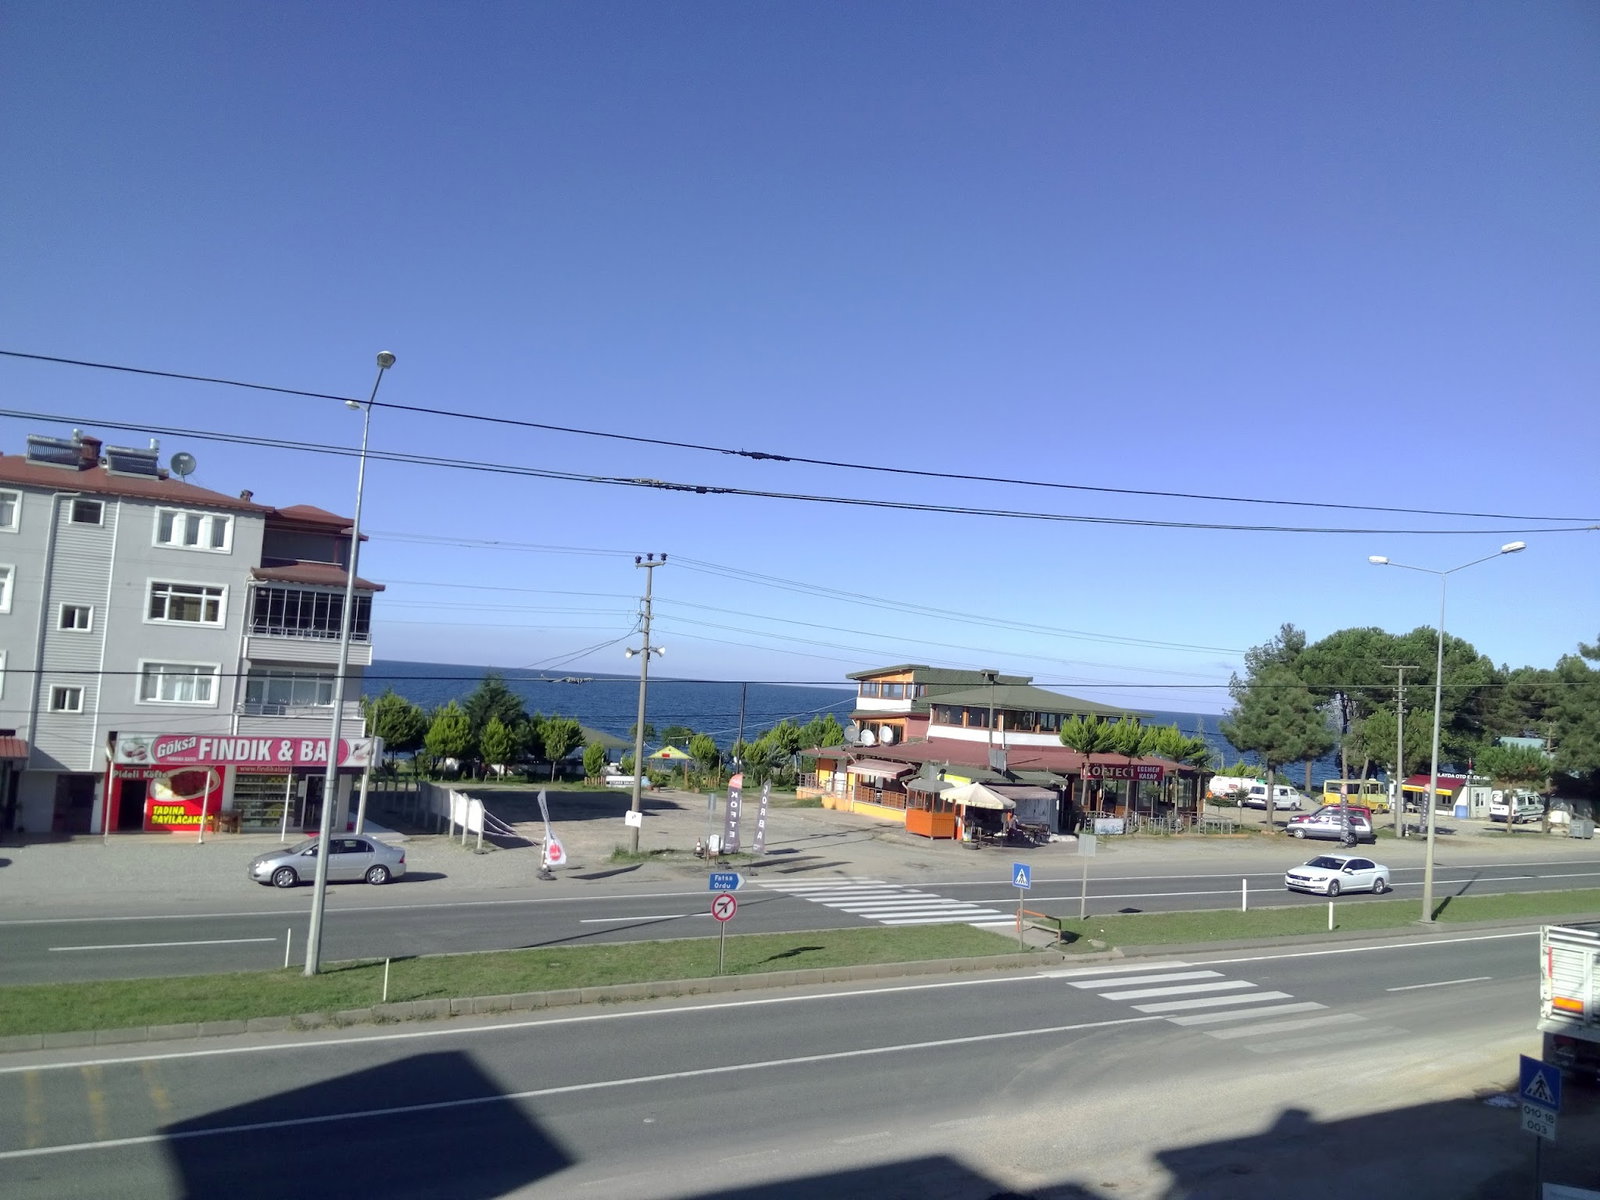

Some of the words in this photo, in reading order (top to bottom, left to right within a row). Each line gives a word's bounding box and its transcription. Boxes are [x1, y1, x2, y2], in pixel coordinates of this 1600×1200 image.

[198, 738, 272, 762] FINDIK
[278, 740, 294, 761] &
[299, 740, 330, 762] BA
[153, 805, 185, 815] TADINA
